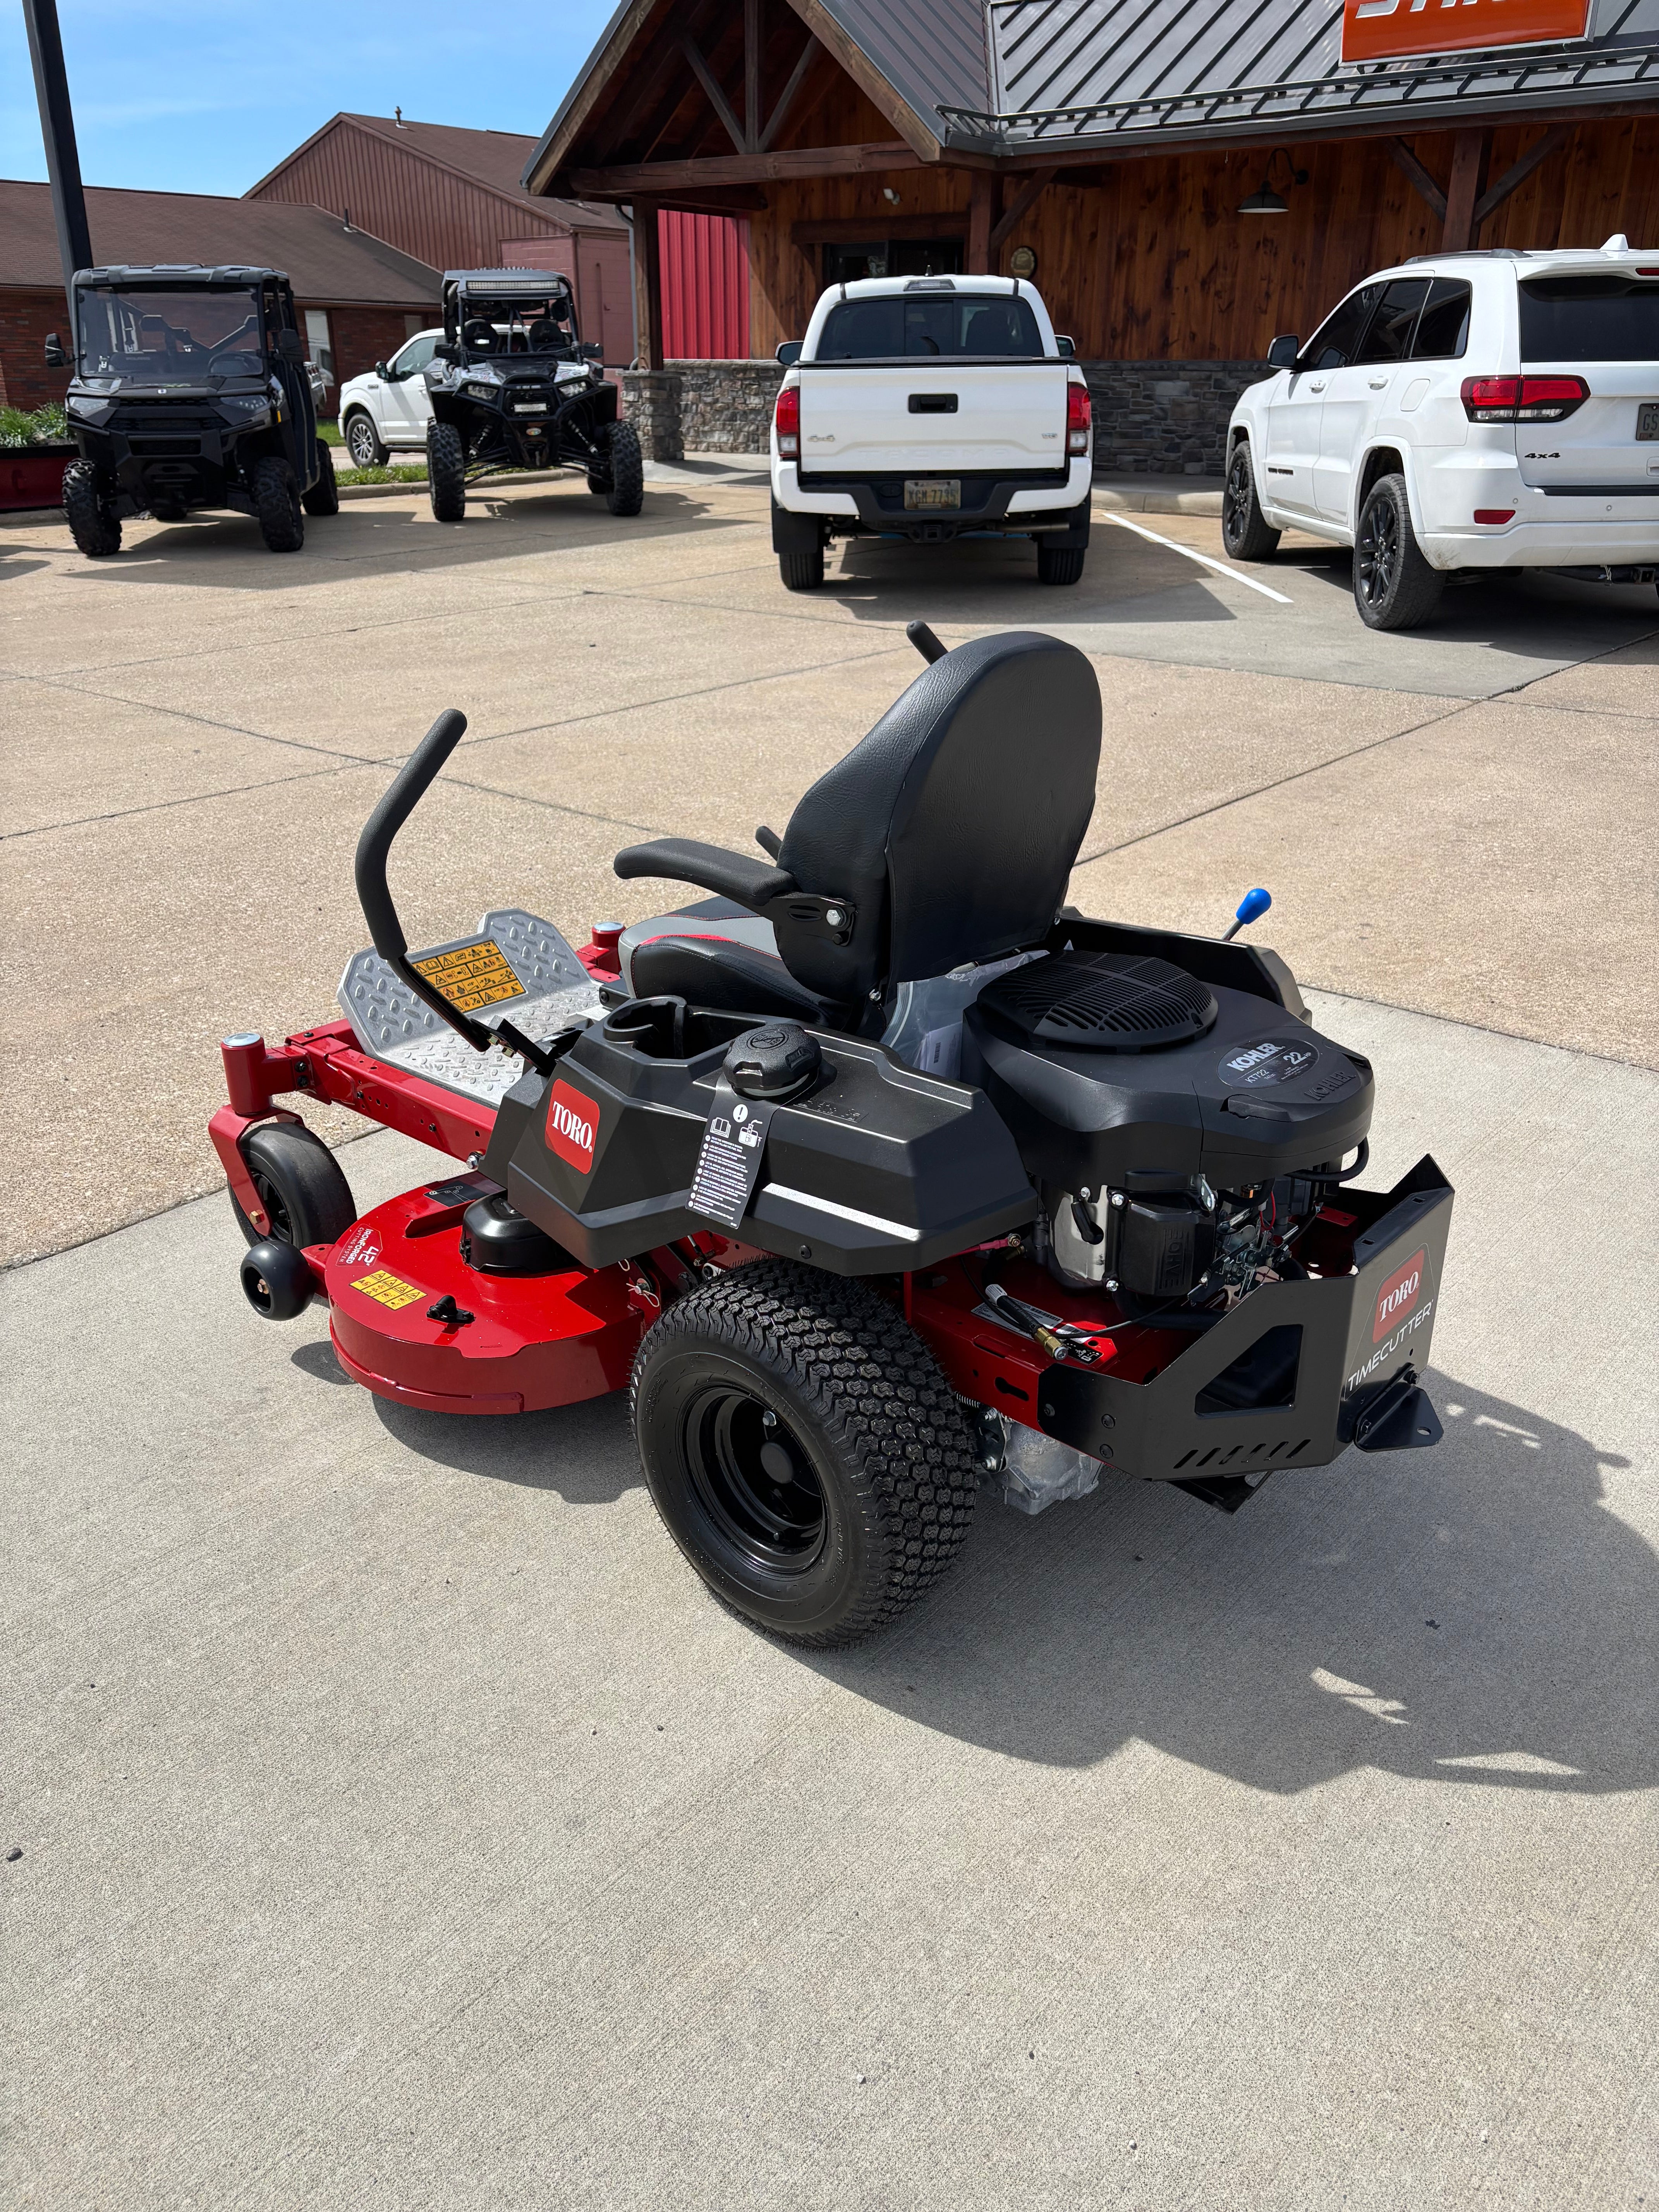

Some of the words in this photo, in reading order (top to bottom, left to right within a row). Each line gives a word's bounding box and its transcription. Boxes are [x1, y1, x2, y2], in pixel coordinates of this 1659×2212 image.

[1226, 1043, 1284, 1072] KOHLER
[1245, 1070, 1270, 1083] KT722
[1304, 1070, 1356, 1100] KOHLER
[552, 1101, 592, 1149] TORO
[346, 1228, 374, 1264] IRONFORGED
[350, 1227, 364, 1245] CUTTING
[1379, 1271, 1419, 1322] TORO
[1347, 1303, 1433, 1391] TIMECUTTER
